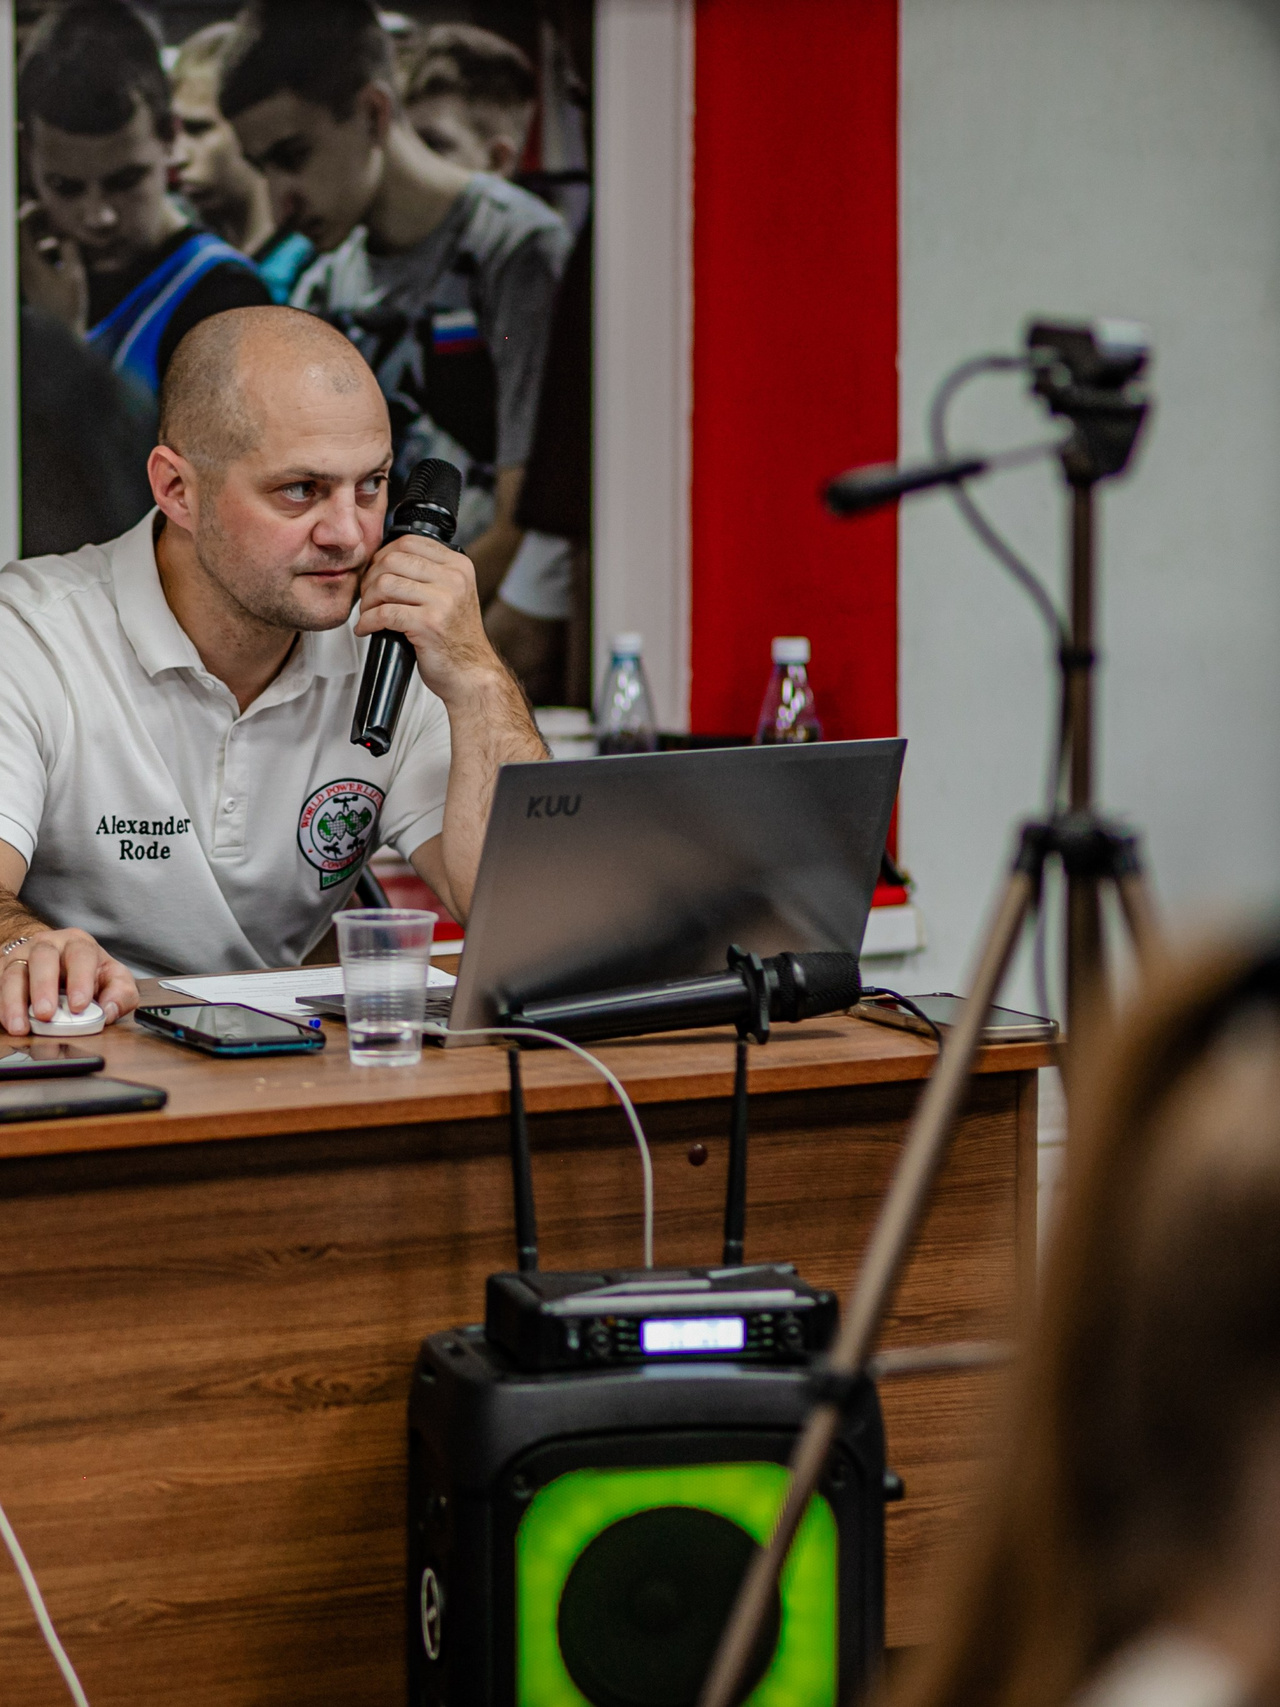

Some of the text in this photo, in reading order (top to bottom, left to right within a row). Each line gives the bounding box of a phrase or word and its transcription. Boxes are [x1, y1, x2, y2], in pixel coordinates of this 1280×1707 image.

[301, 793, 325, 829] WORLD
[526, 794, 582, 819] KUU
[95, 814, 191, 836] Alexander
[119, 839, 171, 860] Rode
